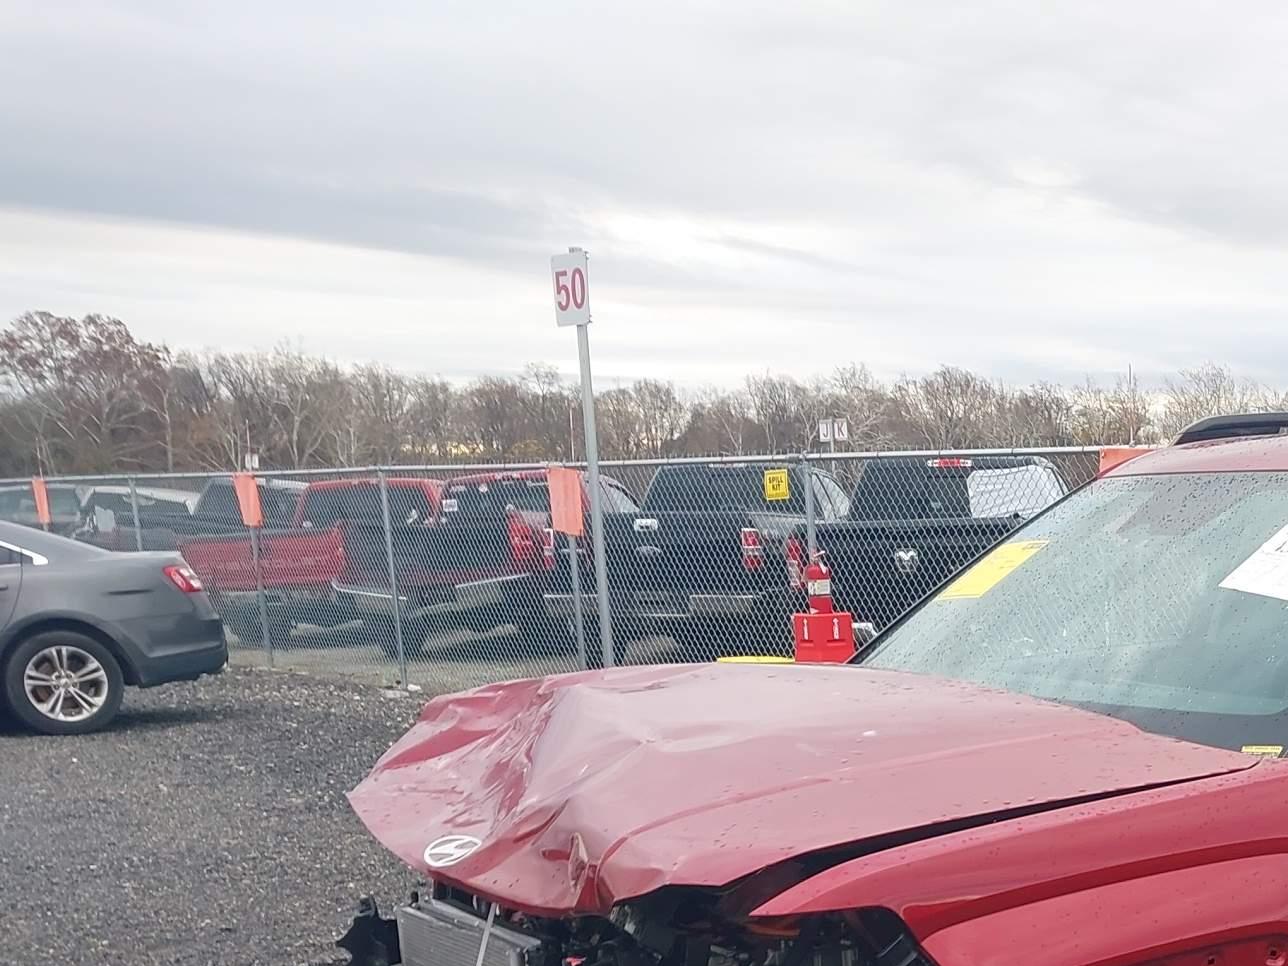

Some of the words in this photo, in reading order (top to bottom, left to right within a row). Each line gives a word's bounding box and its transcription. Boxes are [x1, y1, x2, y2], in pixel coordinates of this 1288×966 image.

[554, 267, 586, 312] 50
[822, 423, 830, 438] J
[836, 422, 846, 437] K
[768, 476, 784, 484] SPILL
